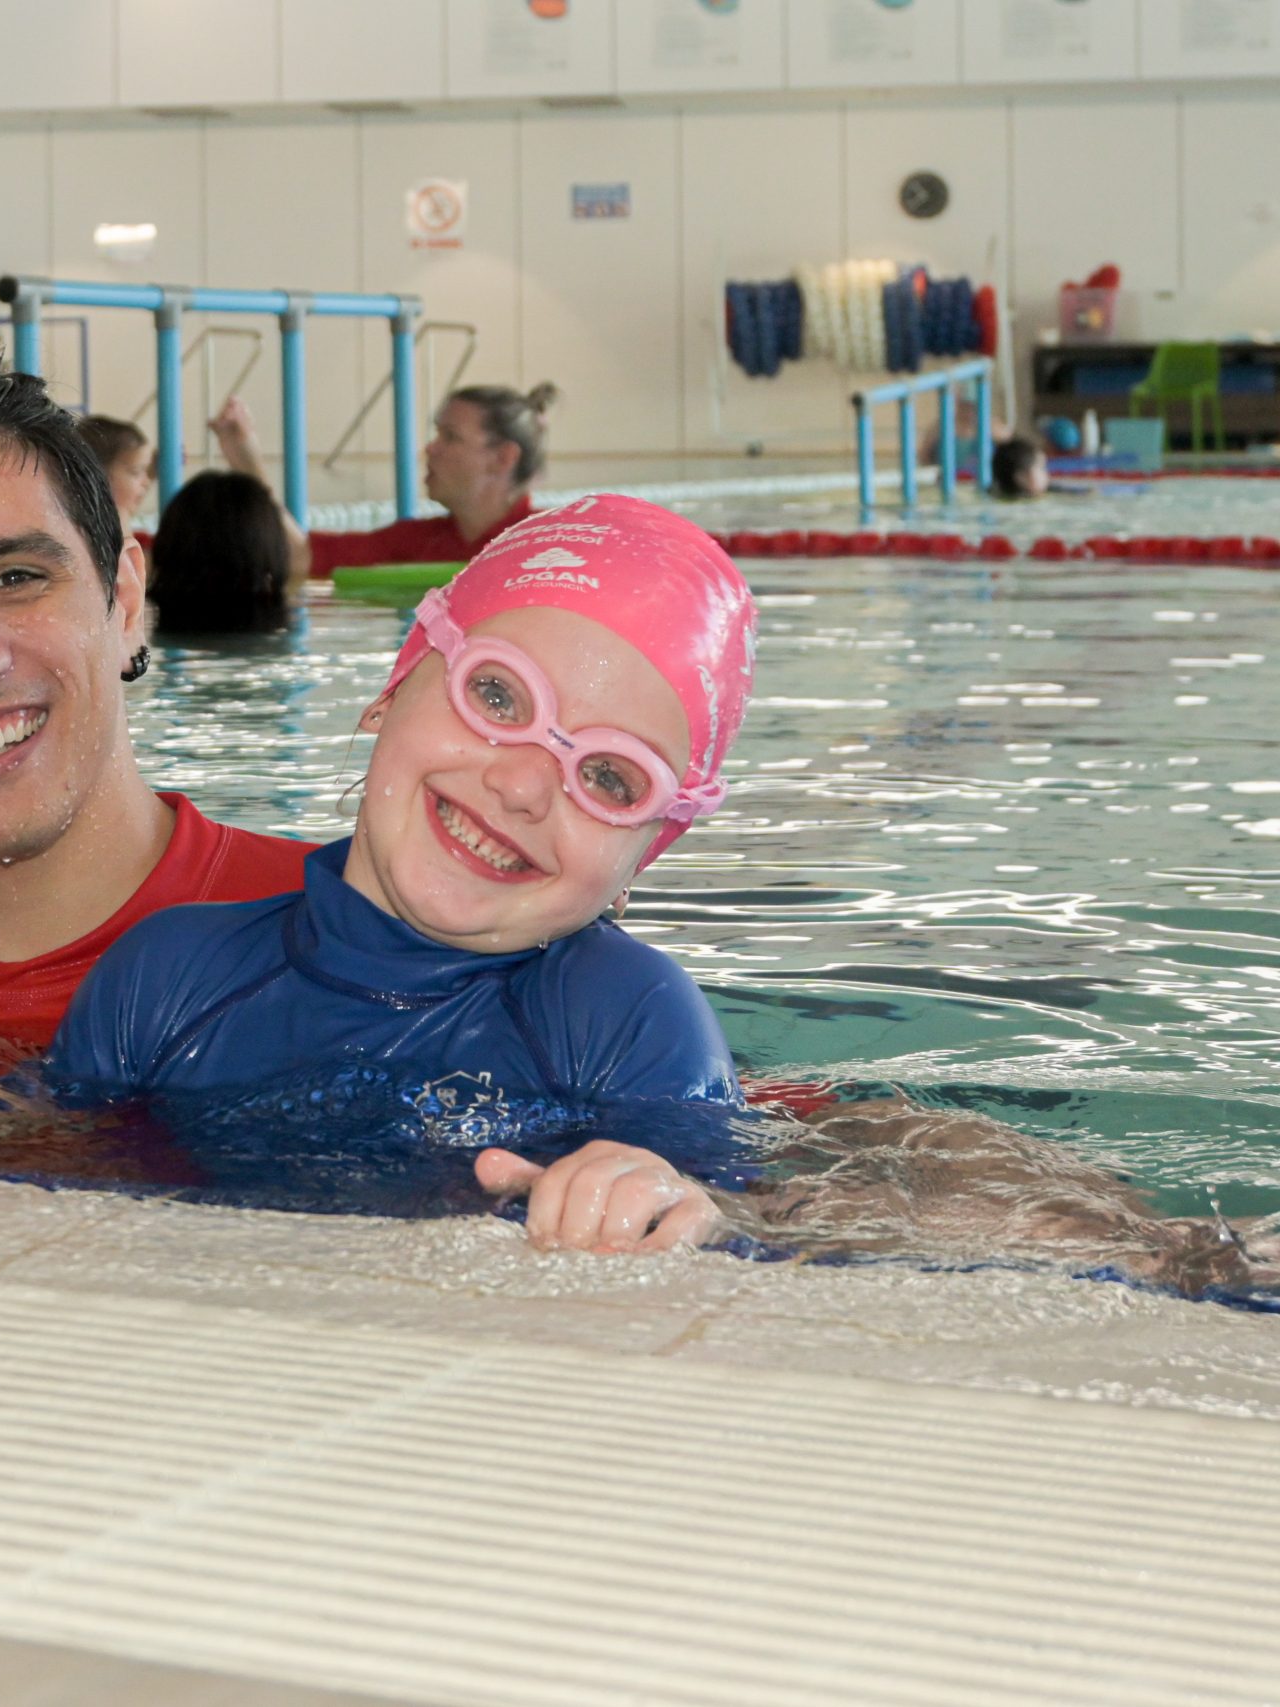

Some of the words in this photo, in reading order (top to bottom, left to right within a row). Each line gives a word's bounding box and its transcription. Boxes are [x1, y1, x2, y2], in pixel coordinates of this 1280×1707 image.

[532, 533, 605, 545] school
[504, 571, 600, 589] LOGAN
[531, 581, 588, 594] COUNCIL
